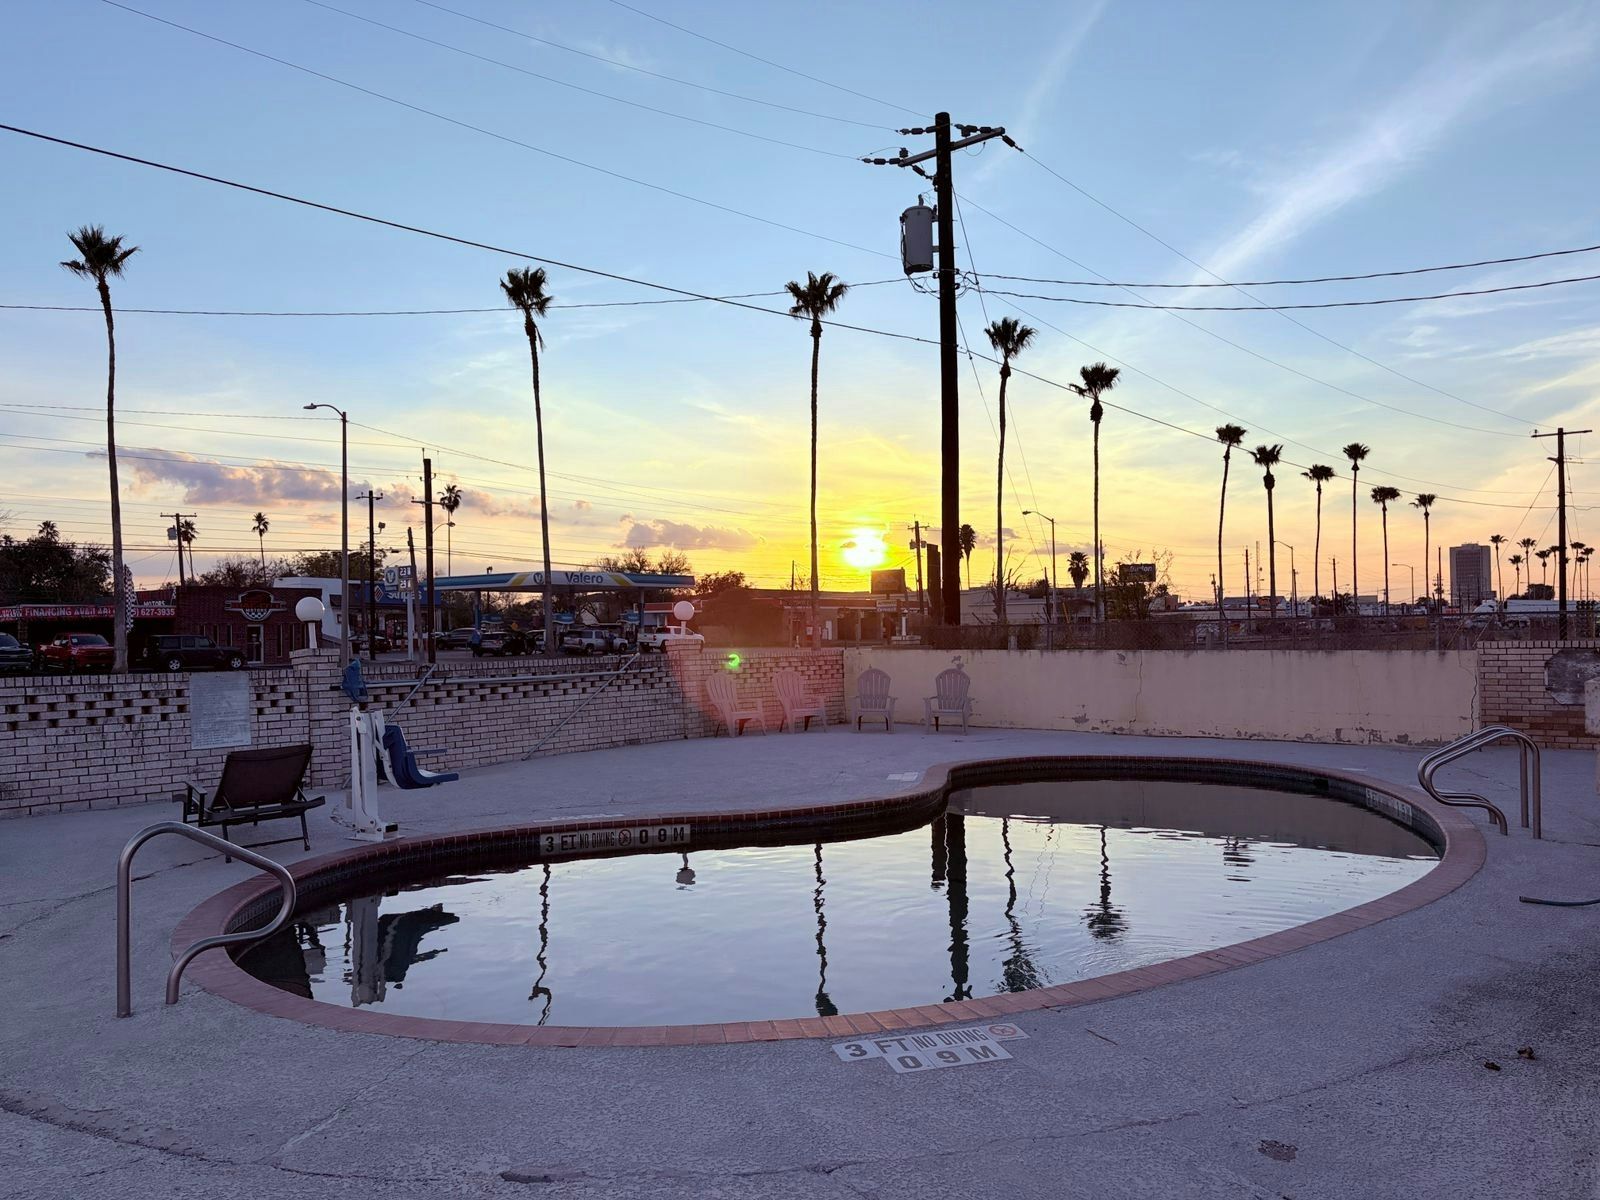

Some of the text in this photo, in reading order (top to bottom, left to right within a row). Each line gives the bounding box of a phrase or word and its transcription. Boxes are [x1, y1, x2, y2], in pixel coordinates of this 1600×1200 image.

[565, 572, 604, 584] Valero
[25, 607, 72, 617] FINANCING
[140, 608, 175, 617] 627-3935
[545, 836, 554, 853] 3
[844, 1029, 989, 1057] 3 FT NO DIVING
[897, 1044, 998, 1069] 0 9 M
